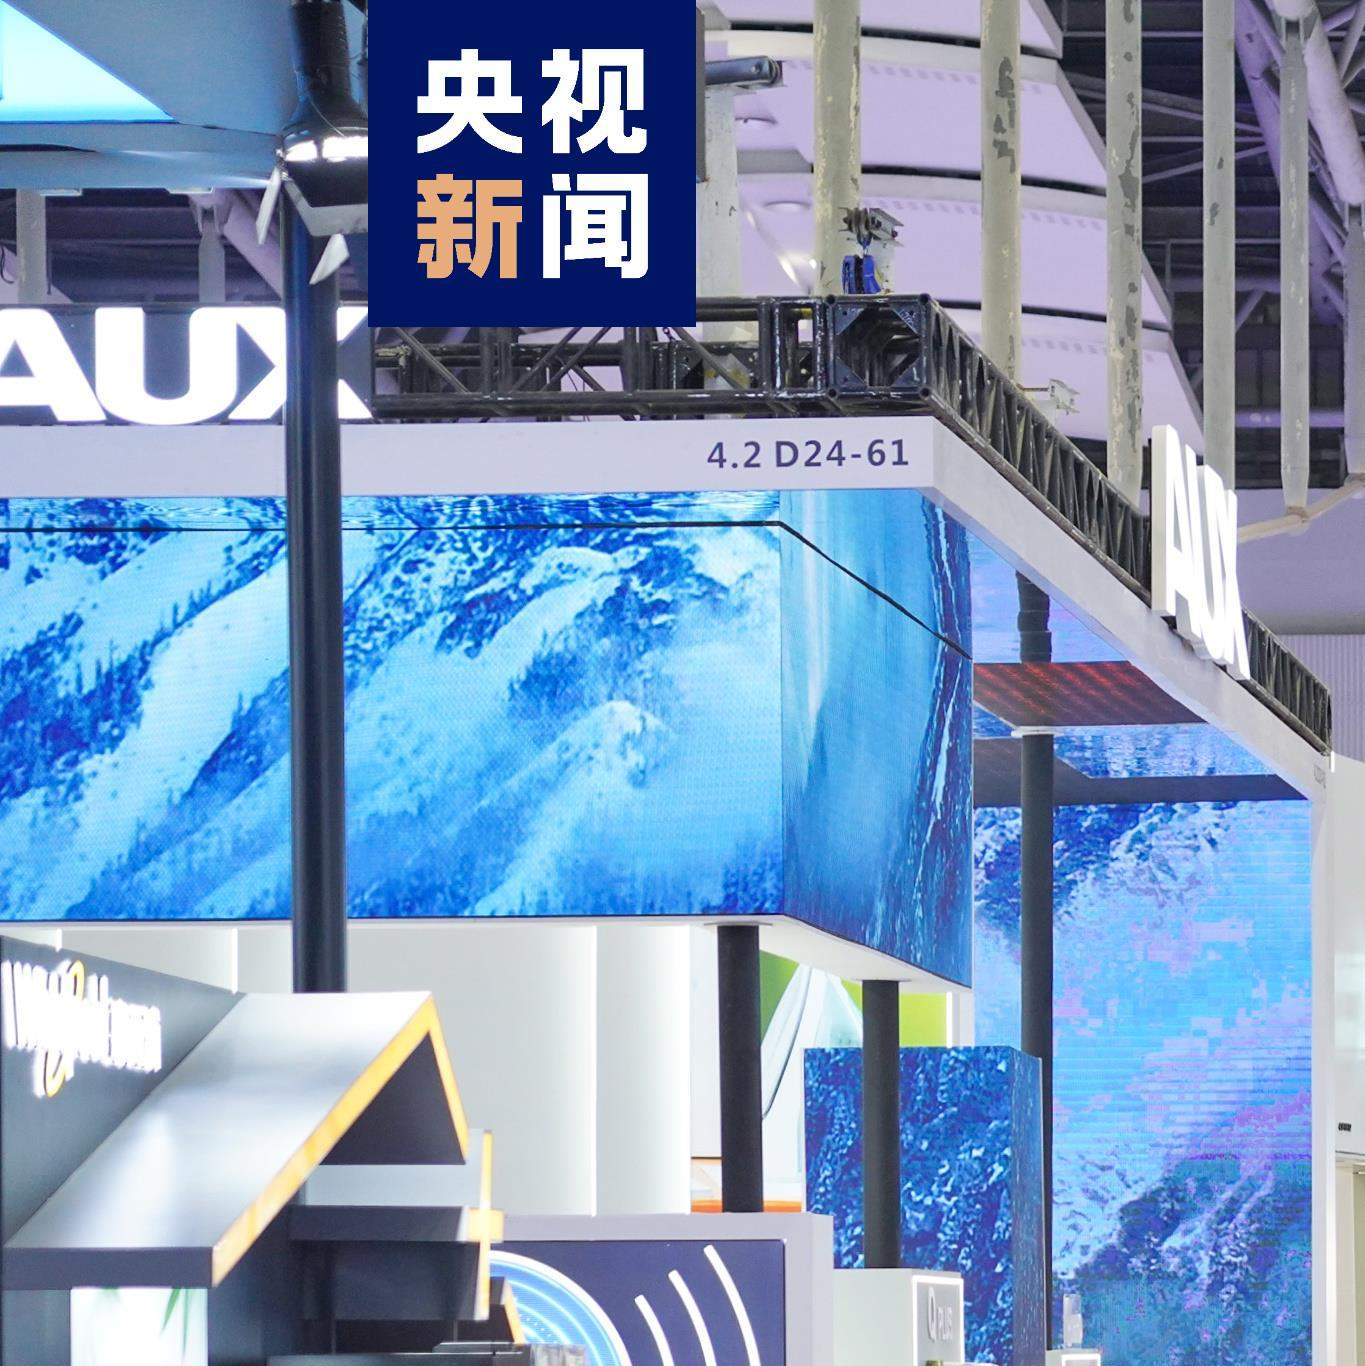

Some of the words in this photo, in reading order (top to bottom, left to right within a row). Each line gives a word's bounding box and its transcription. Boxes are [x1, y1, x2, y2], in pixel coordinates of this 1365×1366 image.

[0, 306, 373, 425] AUX
[707, 441, 761, 469] 4.2
[775, 438, 909, 468] D24-61
[1164, 423, 1250, 681] AUX
